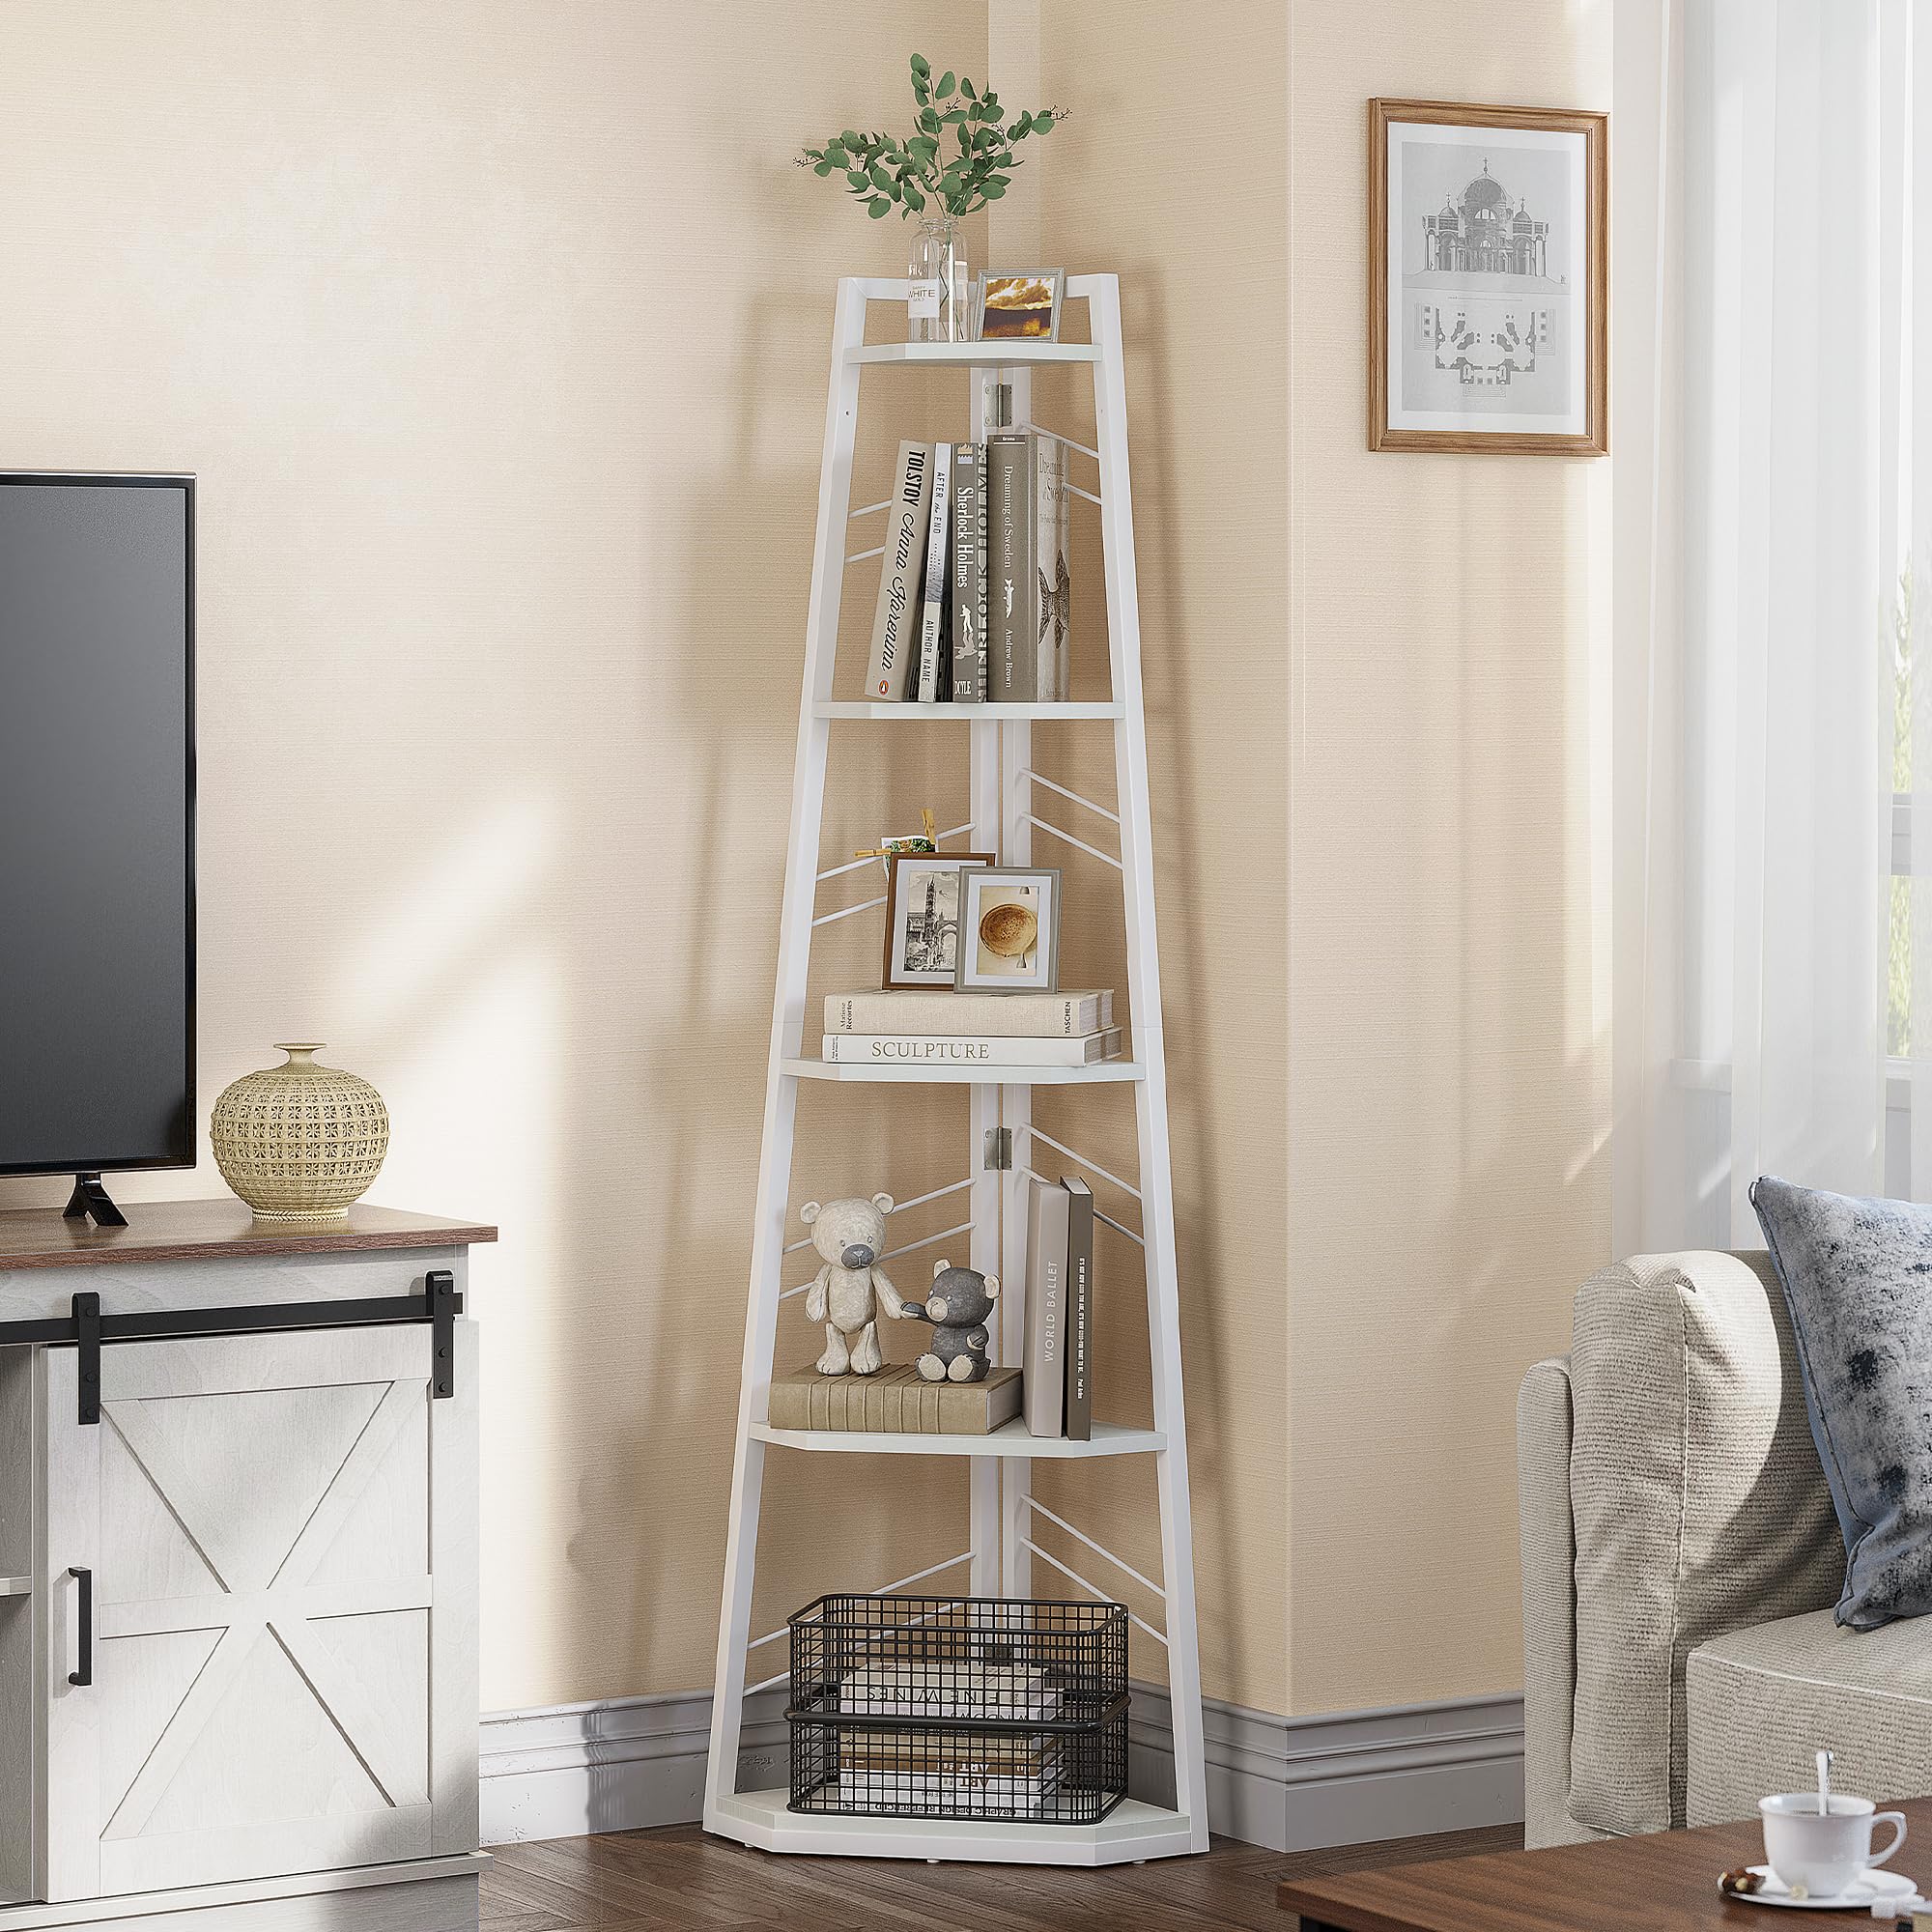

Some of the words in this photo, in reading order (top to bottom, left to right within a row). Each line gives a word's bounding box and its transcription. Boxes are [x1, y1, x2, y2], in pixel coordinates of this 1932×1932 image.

[902, 451, 925, 507] TOLSTOY
[935, 471, 945, 498] AFTER
[1002, 466, 1013, 515] Dreaming
[933, 516, 942, 534] END
[957, 487, 974, 540] Sherlock
[1005, 518, 1014, 527] of
[896, 513, 916, 570] Anna
[1005, 528, 1014, 568] Sweden
[957, 544, 974, 588] Holmes
[880, 576, 907, 671] Karenina
[924, 619, 934, 654] AUTHOR
[922, 659, 931, 683] NAME
[871, 1041, 990, 1060] SCULPTURE
[1046, 1261, 1058, 1308] BALLET
[1044, 1314, 1056, 1362] WORLD
[869, 1688, 939, 1702] WNES
[951, 1690, 999, 1704] FNE
